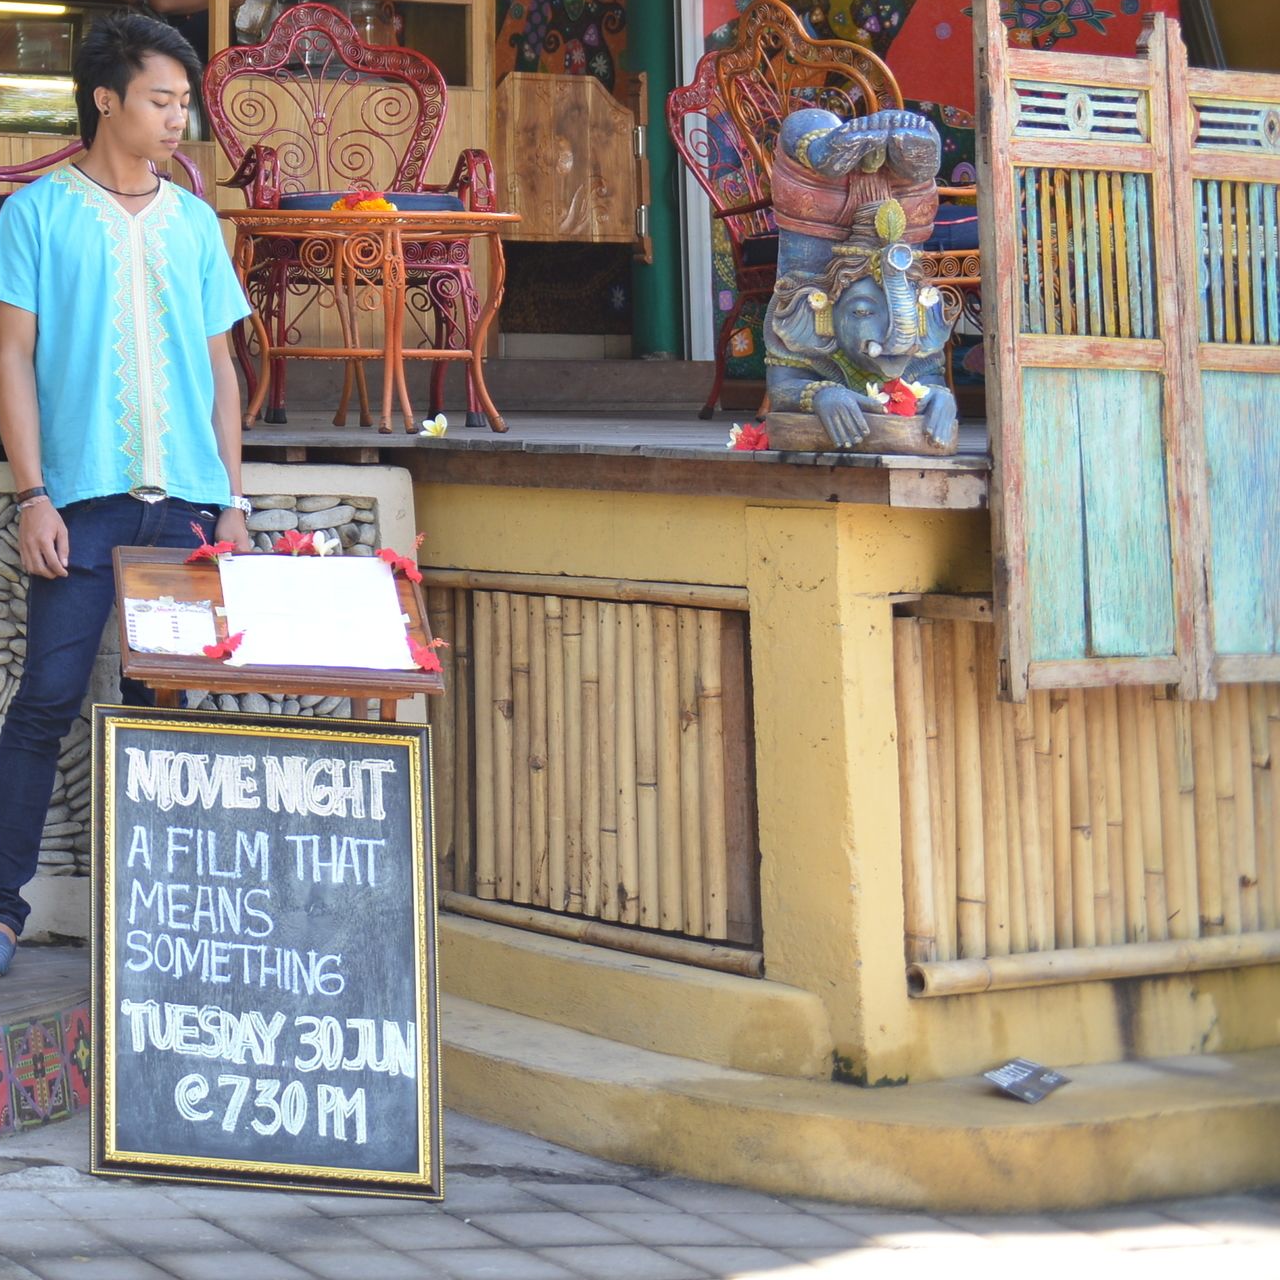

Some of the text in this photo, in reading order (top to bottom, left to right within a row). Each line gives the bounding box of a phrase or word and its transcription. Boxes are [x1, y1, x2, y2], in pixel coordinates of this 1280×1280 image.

[263, 755, 397, 821] NIGHT
[127, 826, 386, 887] A FILM THAT
[128, 878, 274, 938] MEANS
[124, 929, 346, 996] SOMETHING
[294, 1015, 344, 1073] 30
[342, 1018, 417, 1079] JUN
[174, 1073, 214, 1121] @
[317, 1083, 367, 1145] PM
